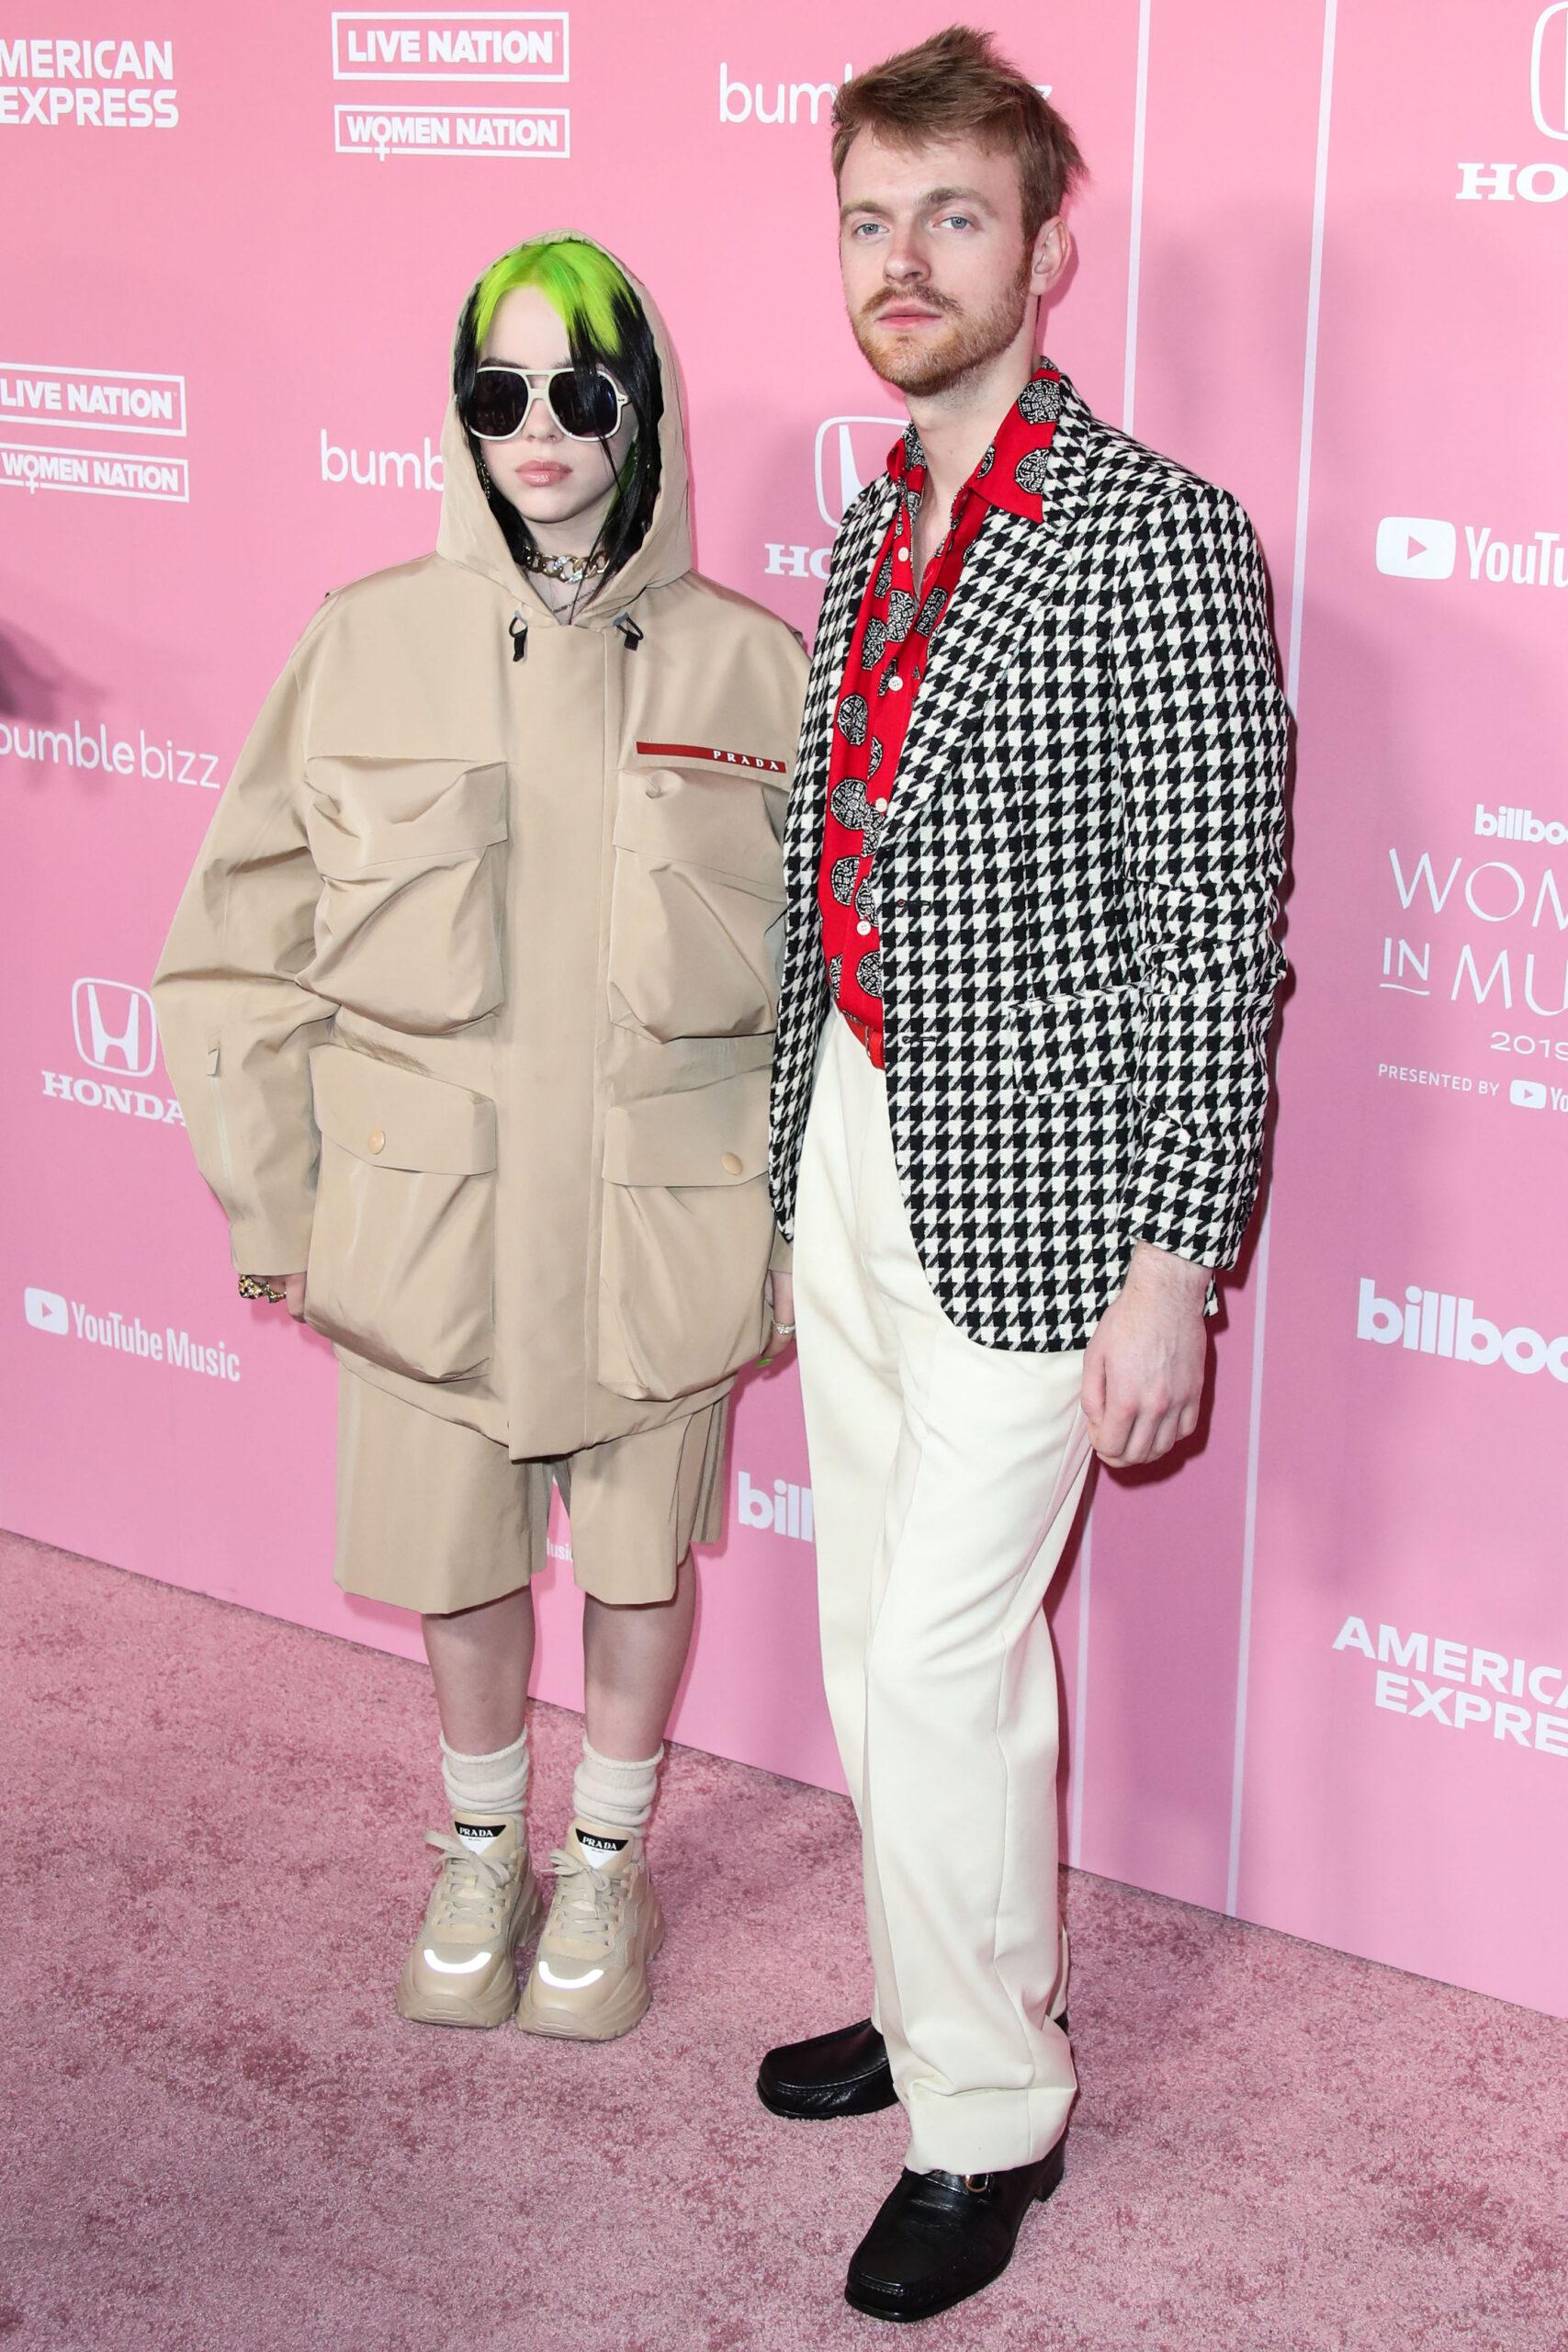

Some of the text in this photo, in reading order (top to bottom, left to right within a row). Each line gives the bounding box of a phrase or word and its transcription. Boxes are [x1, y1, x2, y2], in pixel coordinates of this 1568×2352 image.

[0, 40, 174, 80] MERICAN
[347, 30, 553, 63] LIVE NATION
[0, 86, 179, 128] EXPRESS
[346, 116, 558, 162] WOMEN NATION
[1455, 162, 1568, 203] HO
[0, 378, 173, 420] LIVE NATION
[1, 452, 178, 494] WOMEN NATION
[713, 750, 779, 771] PRADA
[1474, 803, 1568, 845] billbo
[1382, 937, 1429, 981] IN
[41, 1070, 186, 1127] HONDA
[1379, 1063, 1472, 1091] PRESENTED
[1478, 1080, 1499, 1096] BY
[71, 1301, 241, 1382] YouTube Music
[739, 1470, 813, 1543] bill
[1375, 1669, 1568, 1758] EXPRE
[459, 1826, 494, 1837] PRADA
[582, 1836, 617, 1850] PRADA
